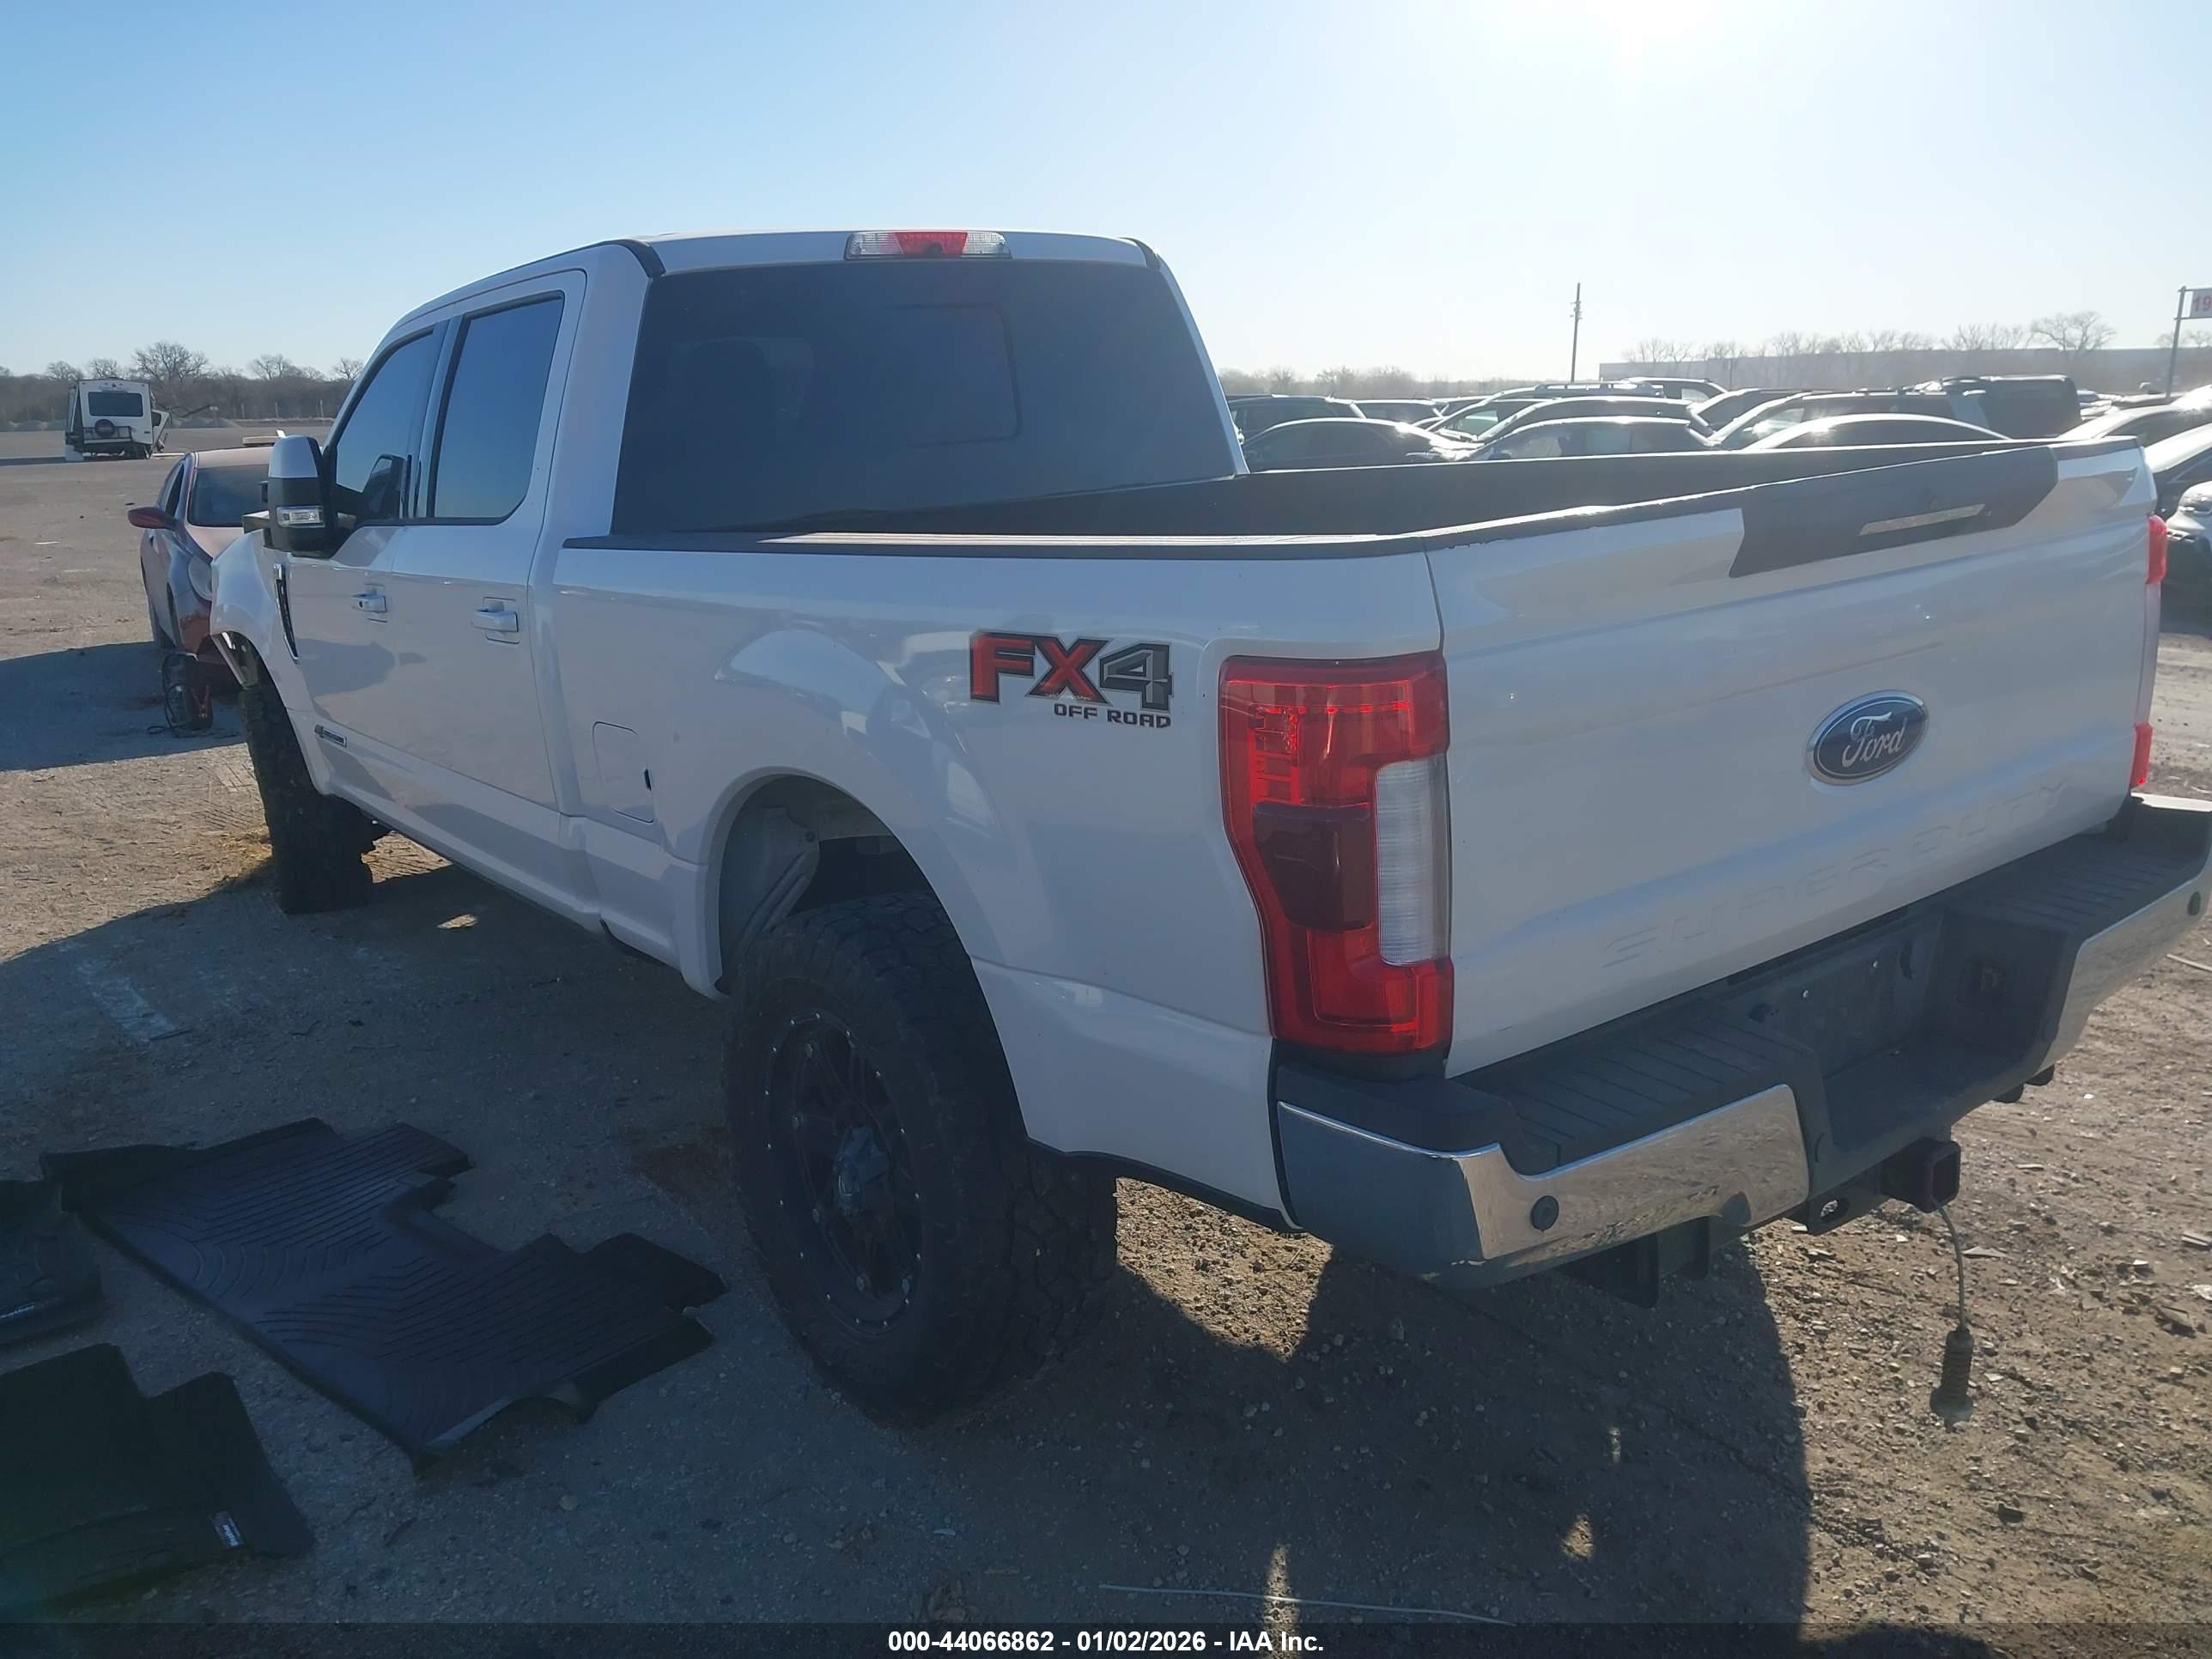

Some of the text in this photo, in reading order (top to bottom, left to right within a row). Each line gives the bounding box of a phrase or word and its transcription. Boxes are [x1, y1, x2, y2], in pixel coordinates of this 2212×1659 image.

[969, 631, 1173, 713] FX4
[1054, 702, 1171, 729] OFF ROAD
[1841, 712, 1907, 767] Ford
[1602, 776, 2069, 969] SUPER DUTY
